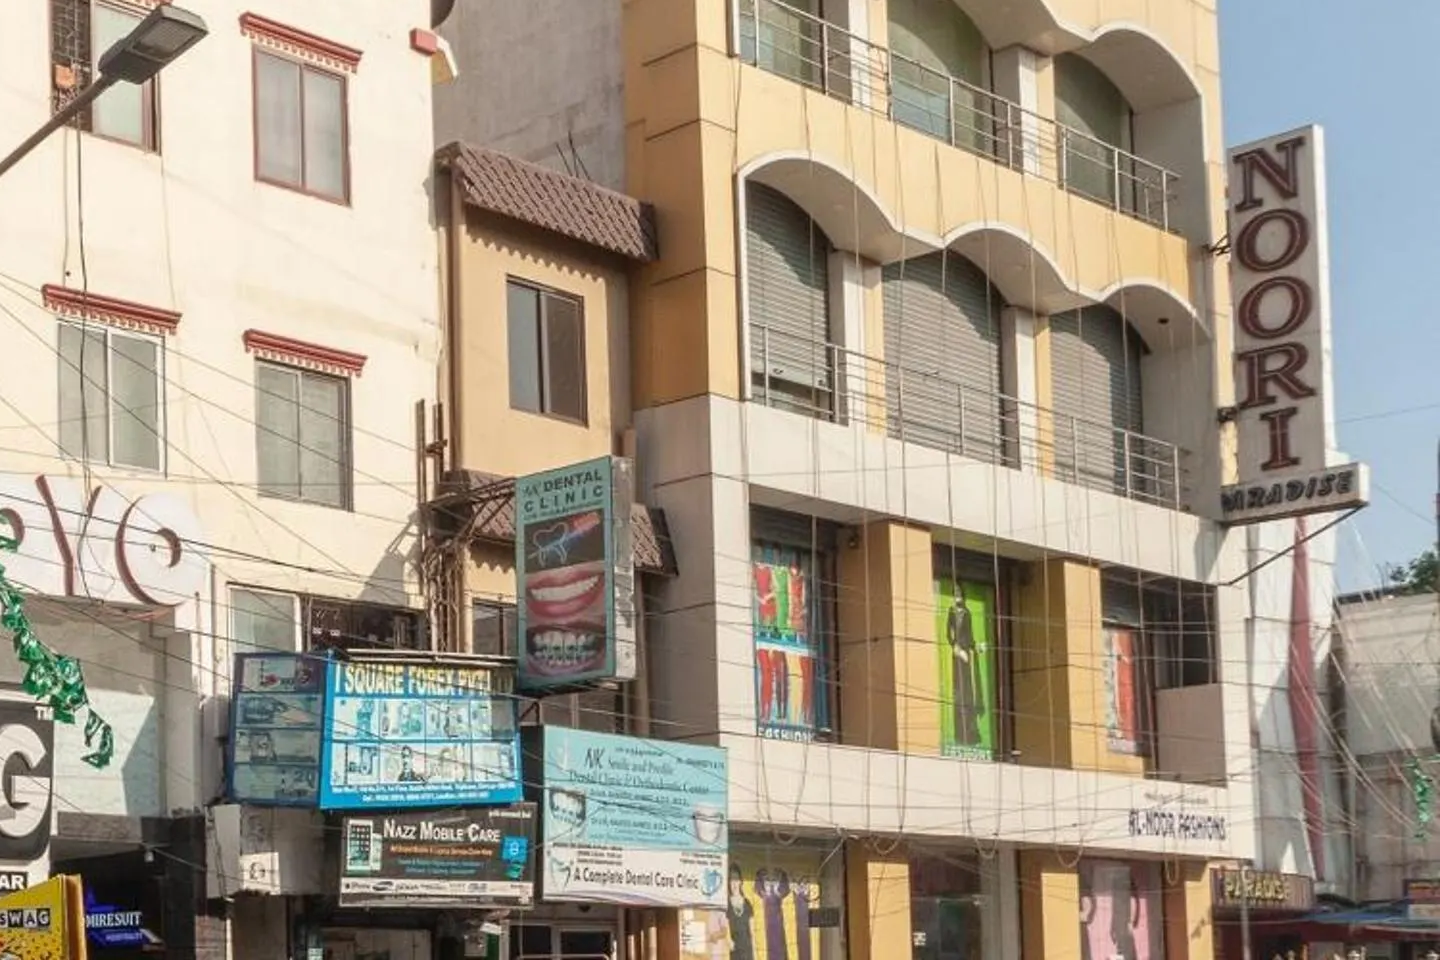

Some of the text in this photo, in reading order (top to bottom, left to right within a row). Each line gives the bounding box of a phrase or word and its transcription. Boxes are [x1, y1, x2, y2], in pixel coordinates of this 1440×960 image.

[1233, 136, 1315, 471] NOORI
[543, 468, 602, 492] DENTAL
[524, 485, 603, 513] CLINIC
[345, 664, 404, 694] SQUARE
[420, 821, 464, 841] MOBILE
[468, 823, 501, 842] CARE
[583, 867, 624, 886] Complete
[626, 869, 652, 886] Dental
[655, 873, 674, 888] Care
